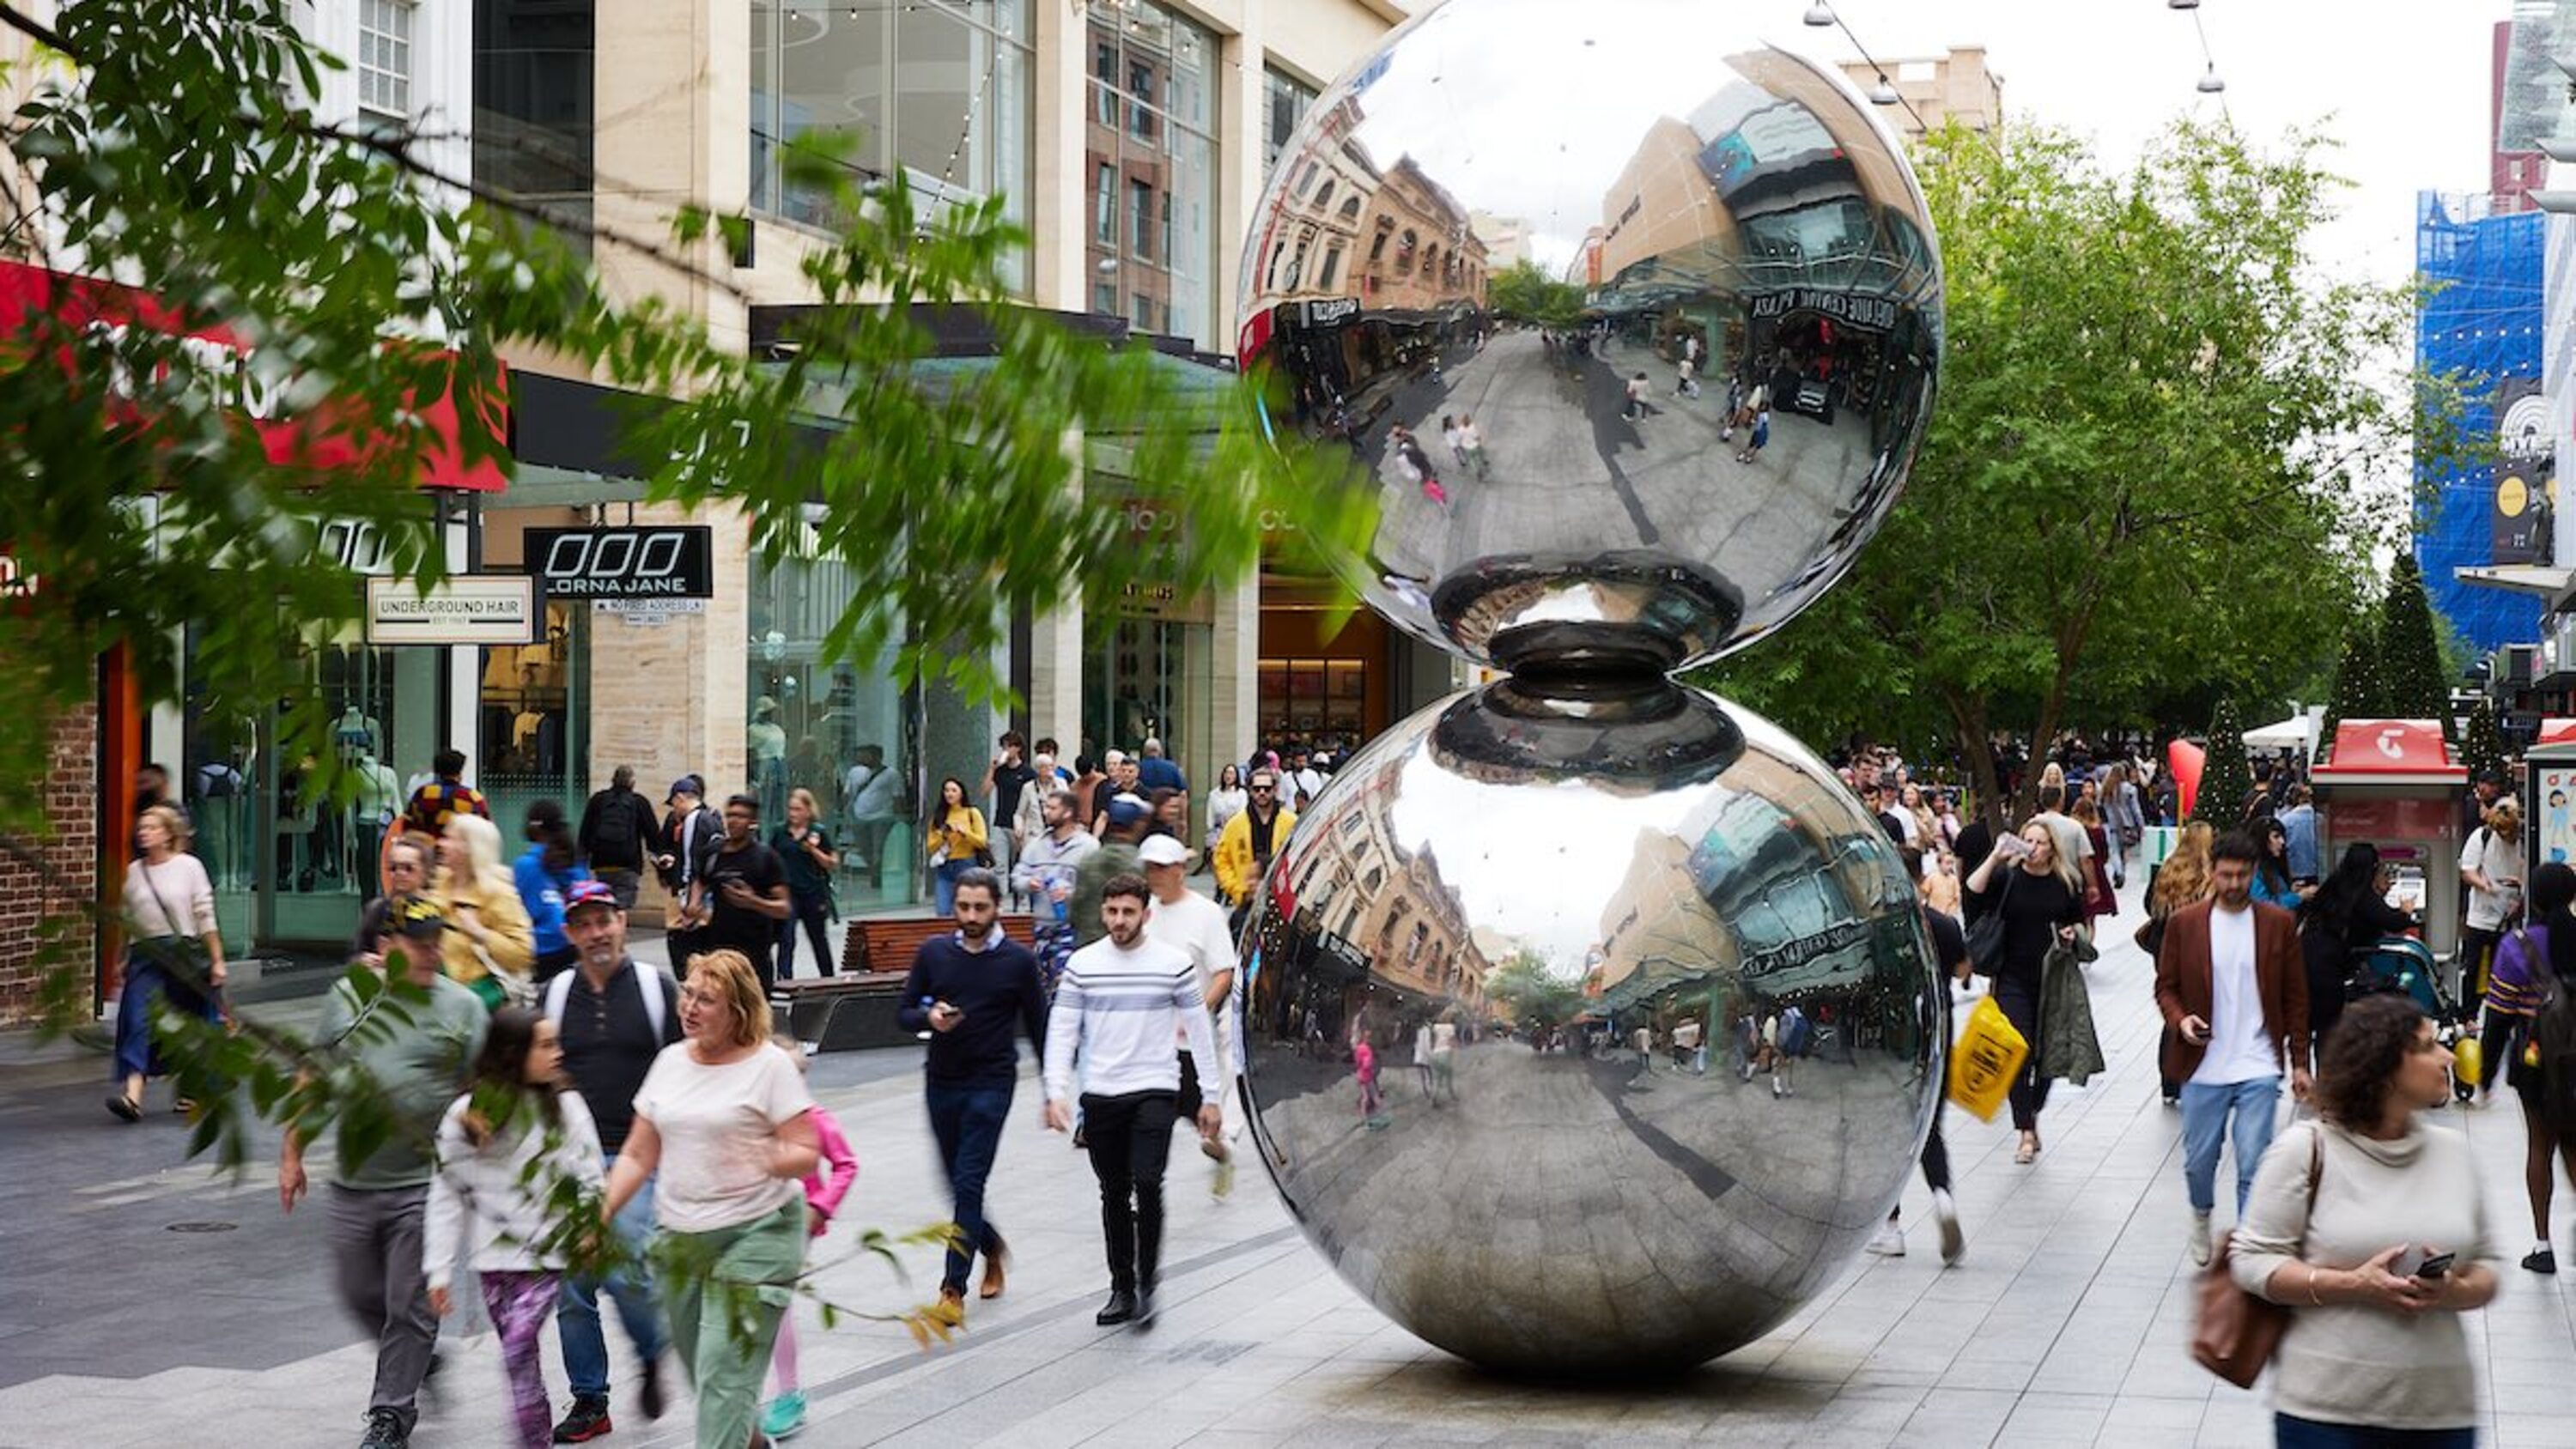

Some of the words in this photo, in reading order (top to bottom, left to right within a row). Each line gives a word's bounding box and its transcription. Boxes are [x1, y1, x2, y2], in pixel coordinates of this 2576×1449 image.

[624, 578, 686, 592] JANE
[381, 600, 483, 614] UNDERGROUND
[486, 600, 519, 614] HAIR
